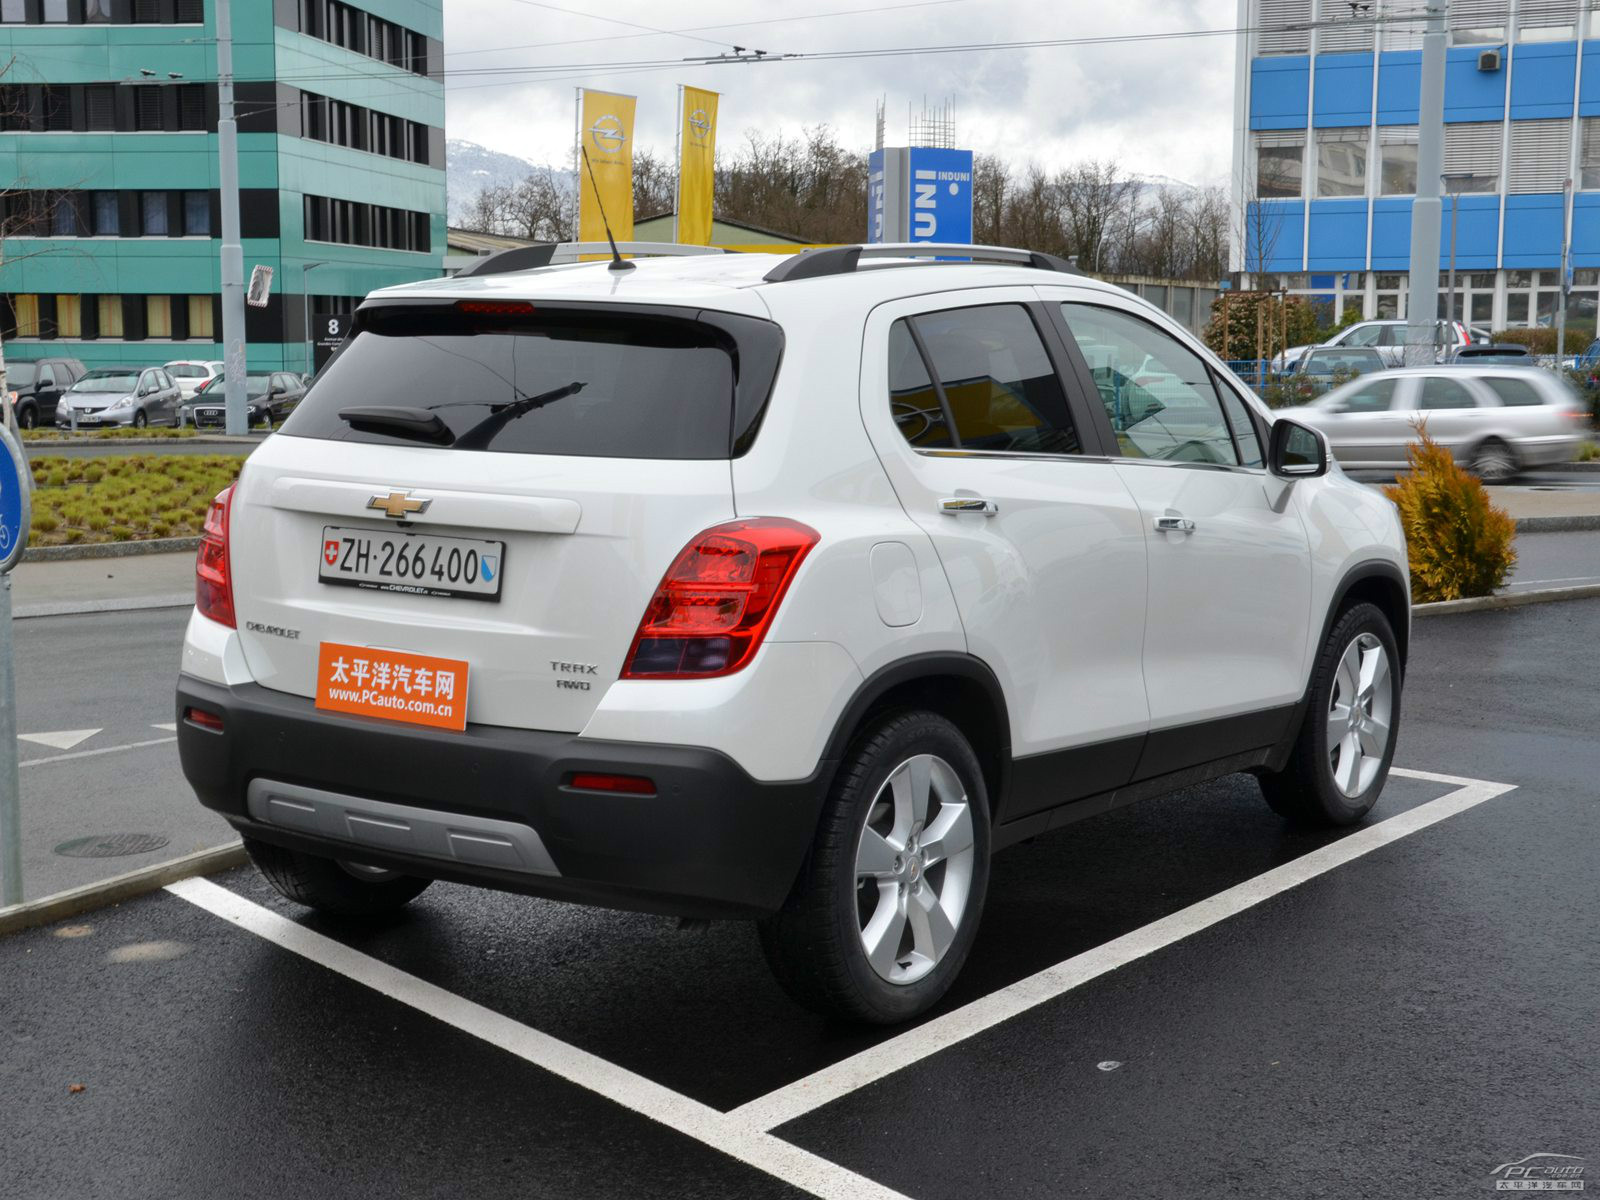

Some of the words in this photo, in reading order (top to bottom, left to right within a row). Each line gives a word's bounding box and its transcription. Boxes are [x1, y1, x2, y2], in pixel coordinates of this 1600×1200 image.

[938, 171, 970, 182] INDUNI
[915, 169, 937, 243] UNI
[328, 318, 339, 335] 8
[550, 661, 598, 676] TRAX
[329, 656, 456, 700] 太平洋汽车网
[556, 680, 591, 691] AWD
[328, 687, 454, 717] www.PCauto.com.cn
